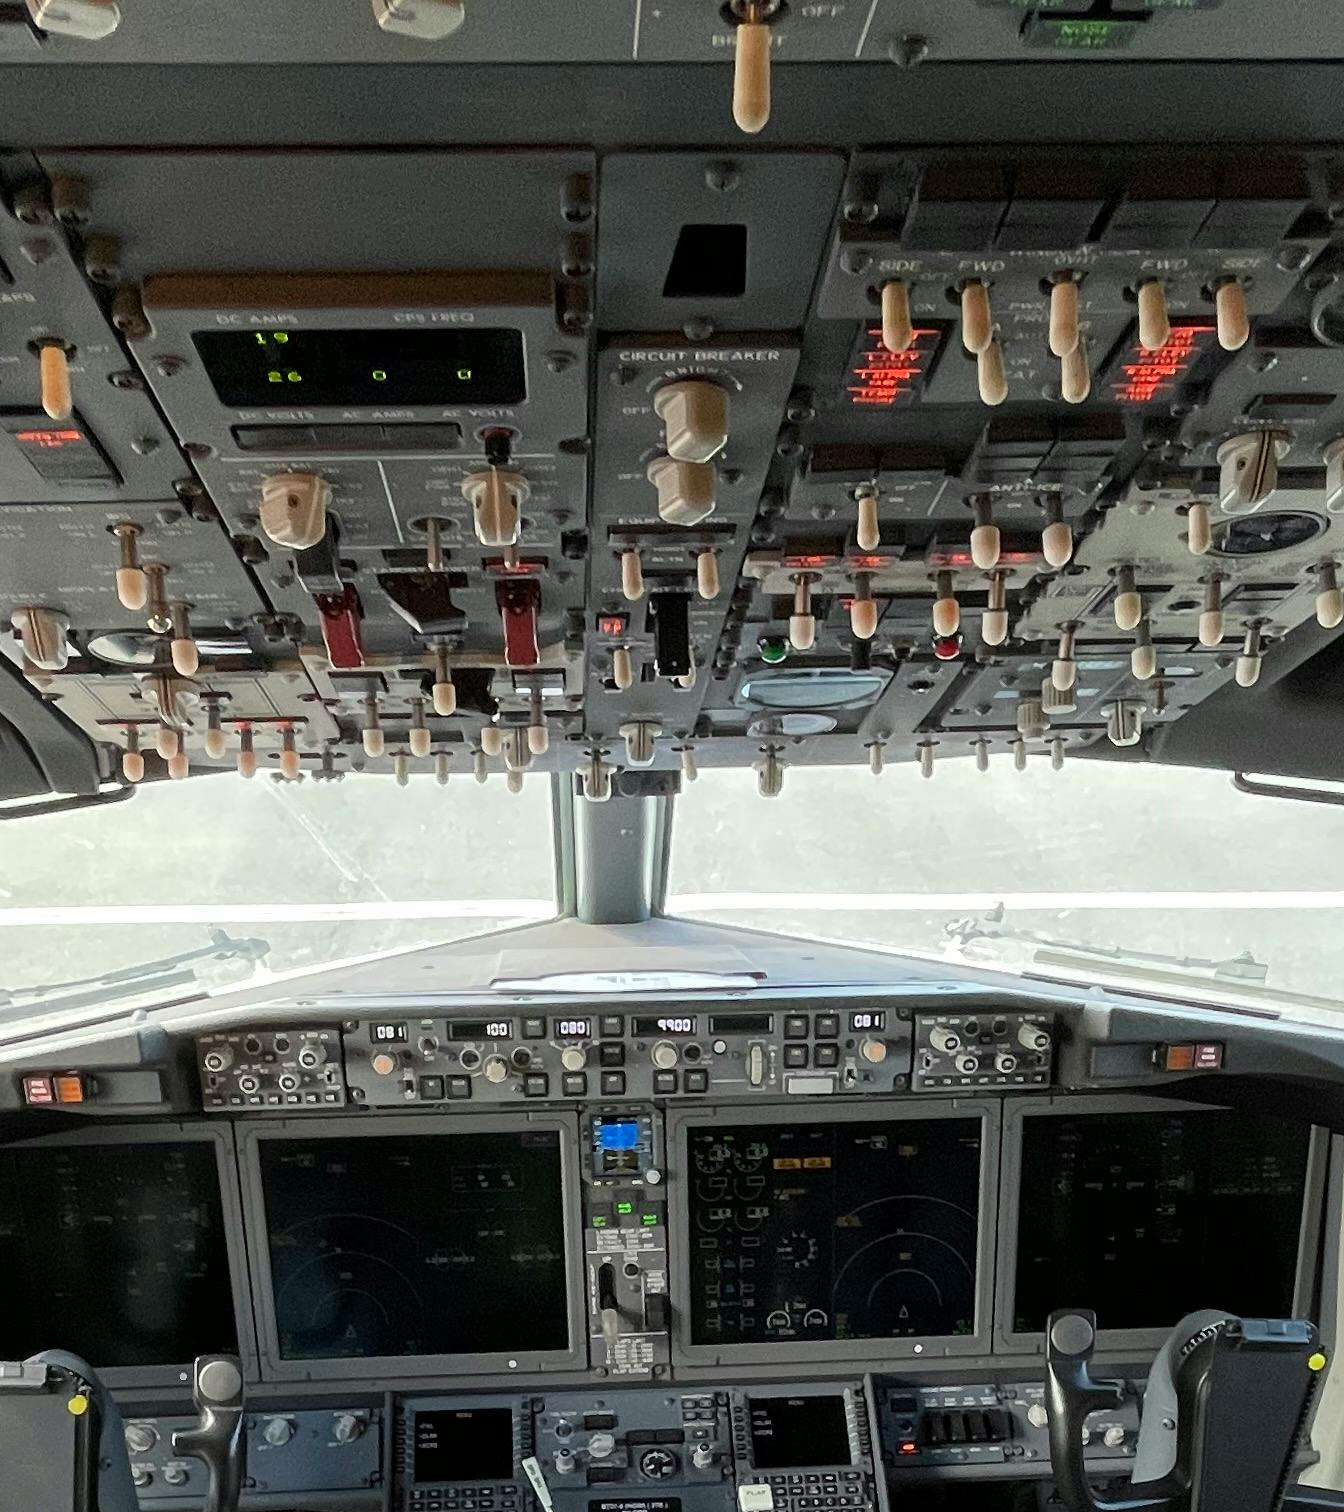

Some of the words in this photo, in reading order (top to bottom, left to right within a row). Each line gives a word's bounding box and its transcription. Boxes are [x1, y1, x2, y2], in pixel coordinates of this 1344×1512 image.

[879, 260, 923, 272] SIDE
[958, 260, 1006, 273] FWD
[619, 351, 687, 362] CIRCUIT
[694, 350, 780, 362] BREAKER
[486, 1023, 507, 1036] 100
